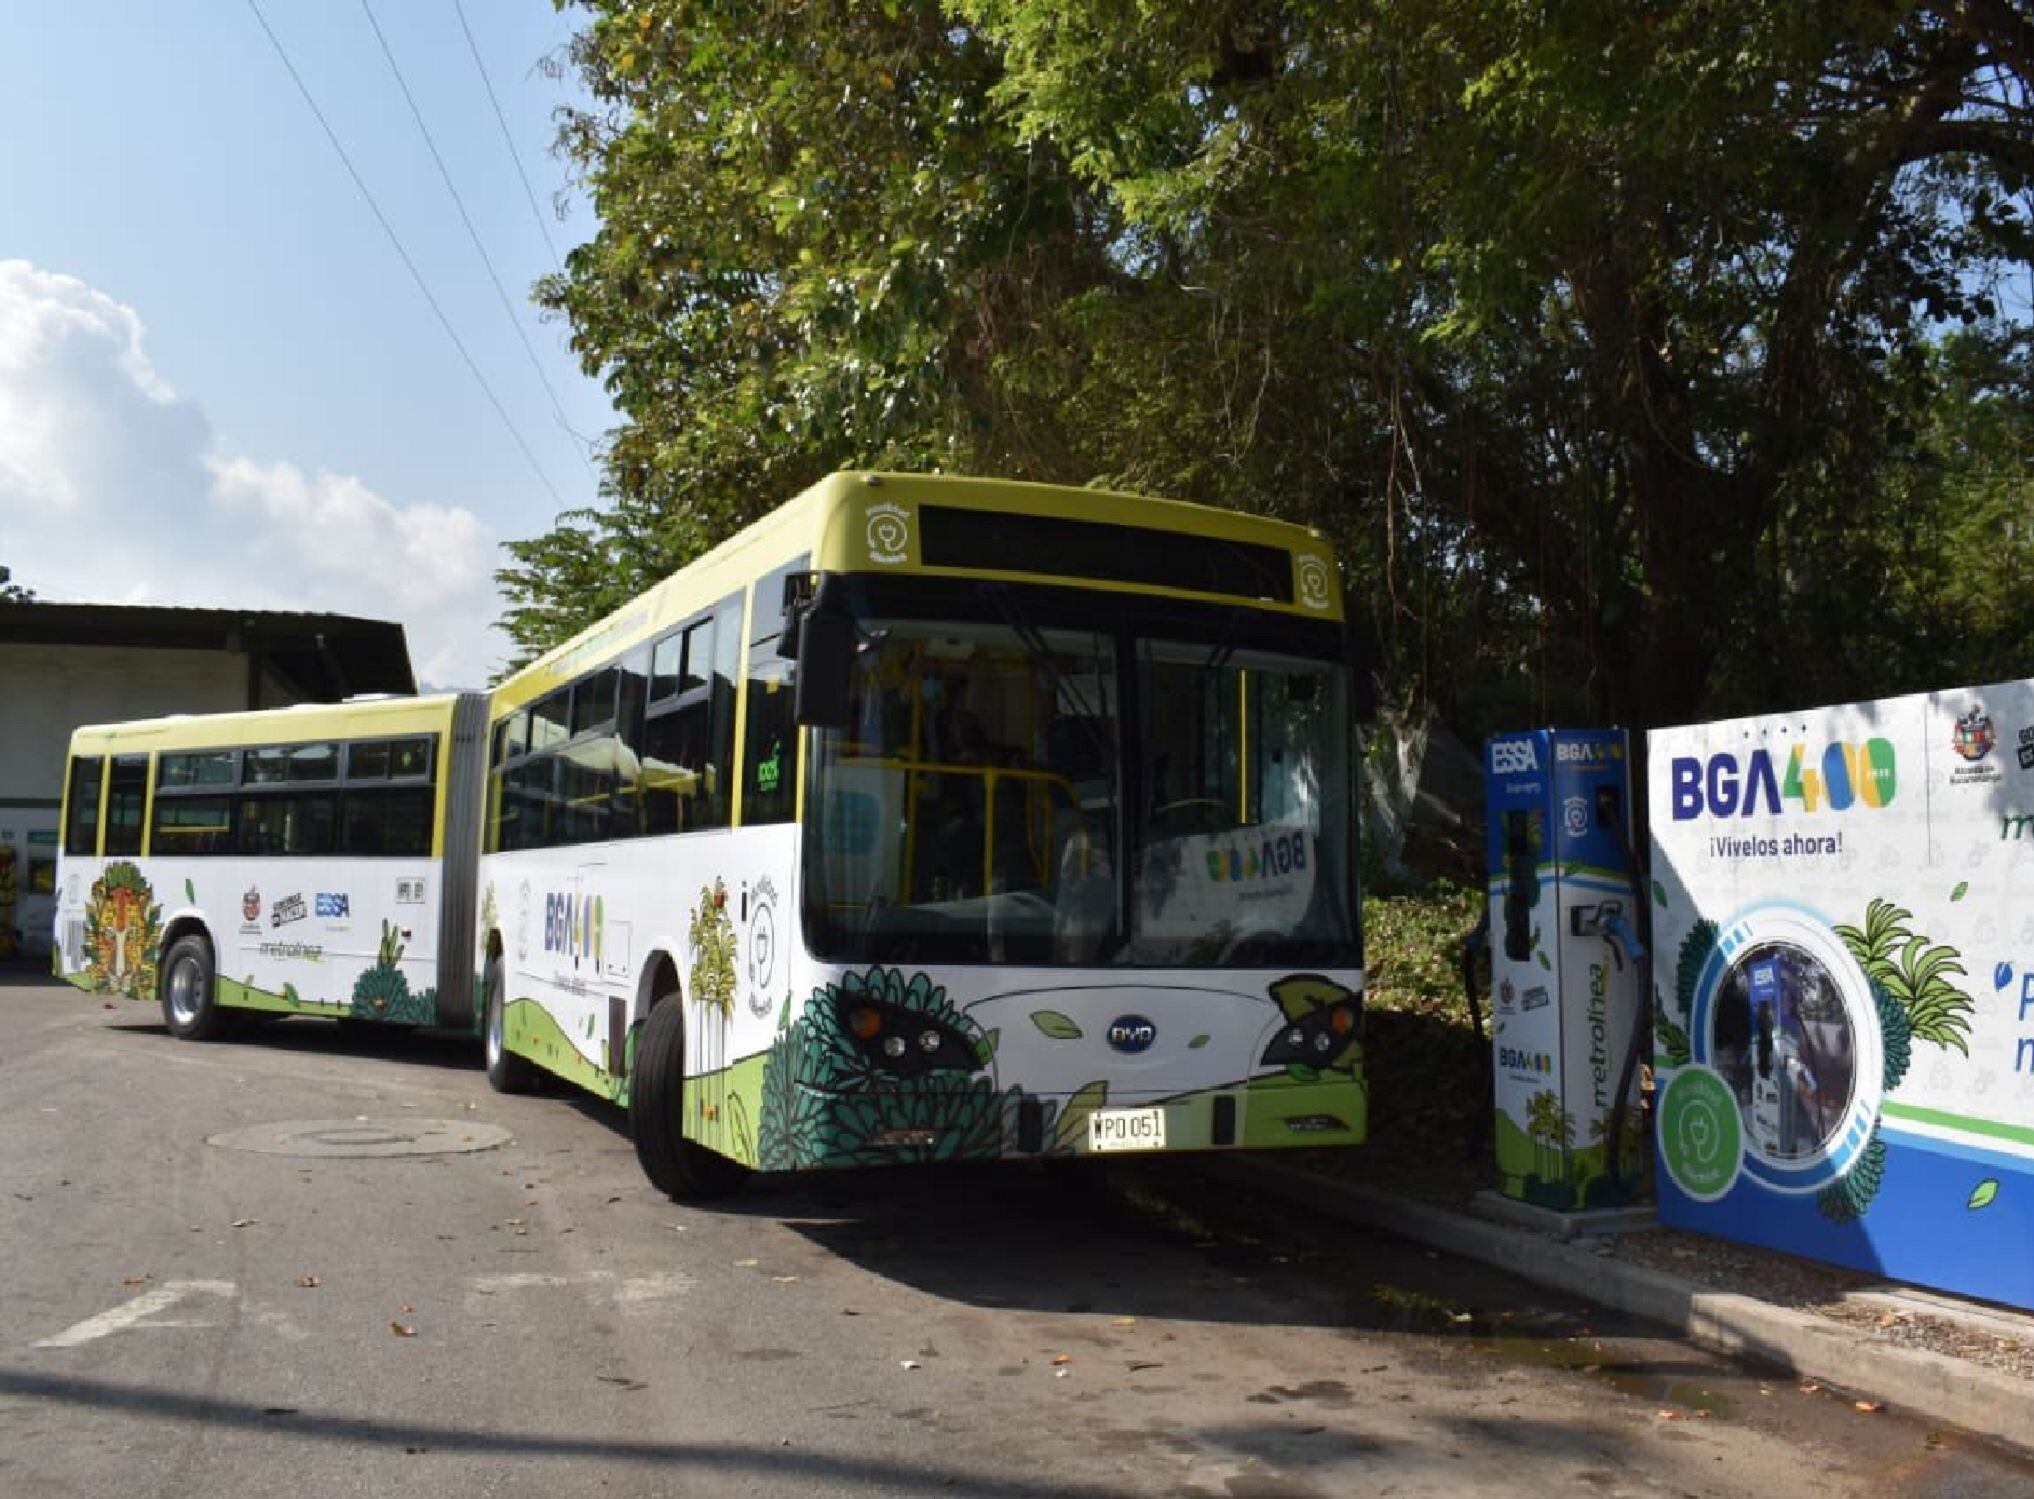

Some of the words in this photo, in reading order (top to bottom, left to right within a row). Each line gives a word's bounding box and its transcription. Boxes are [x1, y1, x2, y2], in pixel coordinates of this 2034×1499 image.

[1492, 739, 1537, 774] ESSA
[1672, 737, 1896, 822] BGA400
[1783, 832, 1843, 856] ahora!
[1111, 1027, 1152, 1041] BYD
